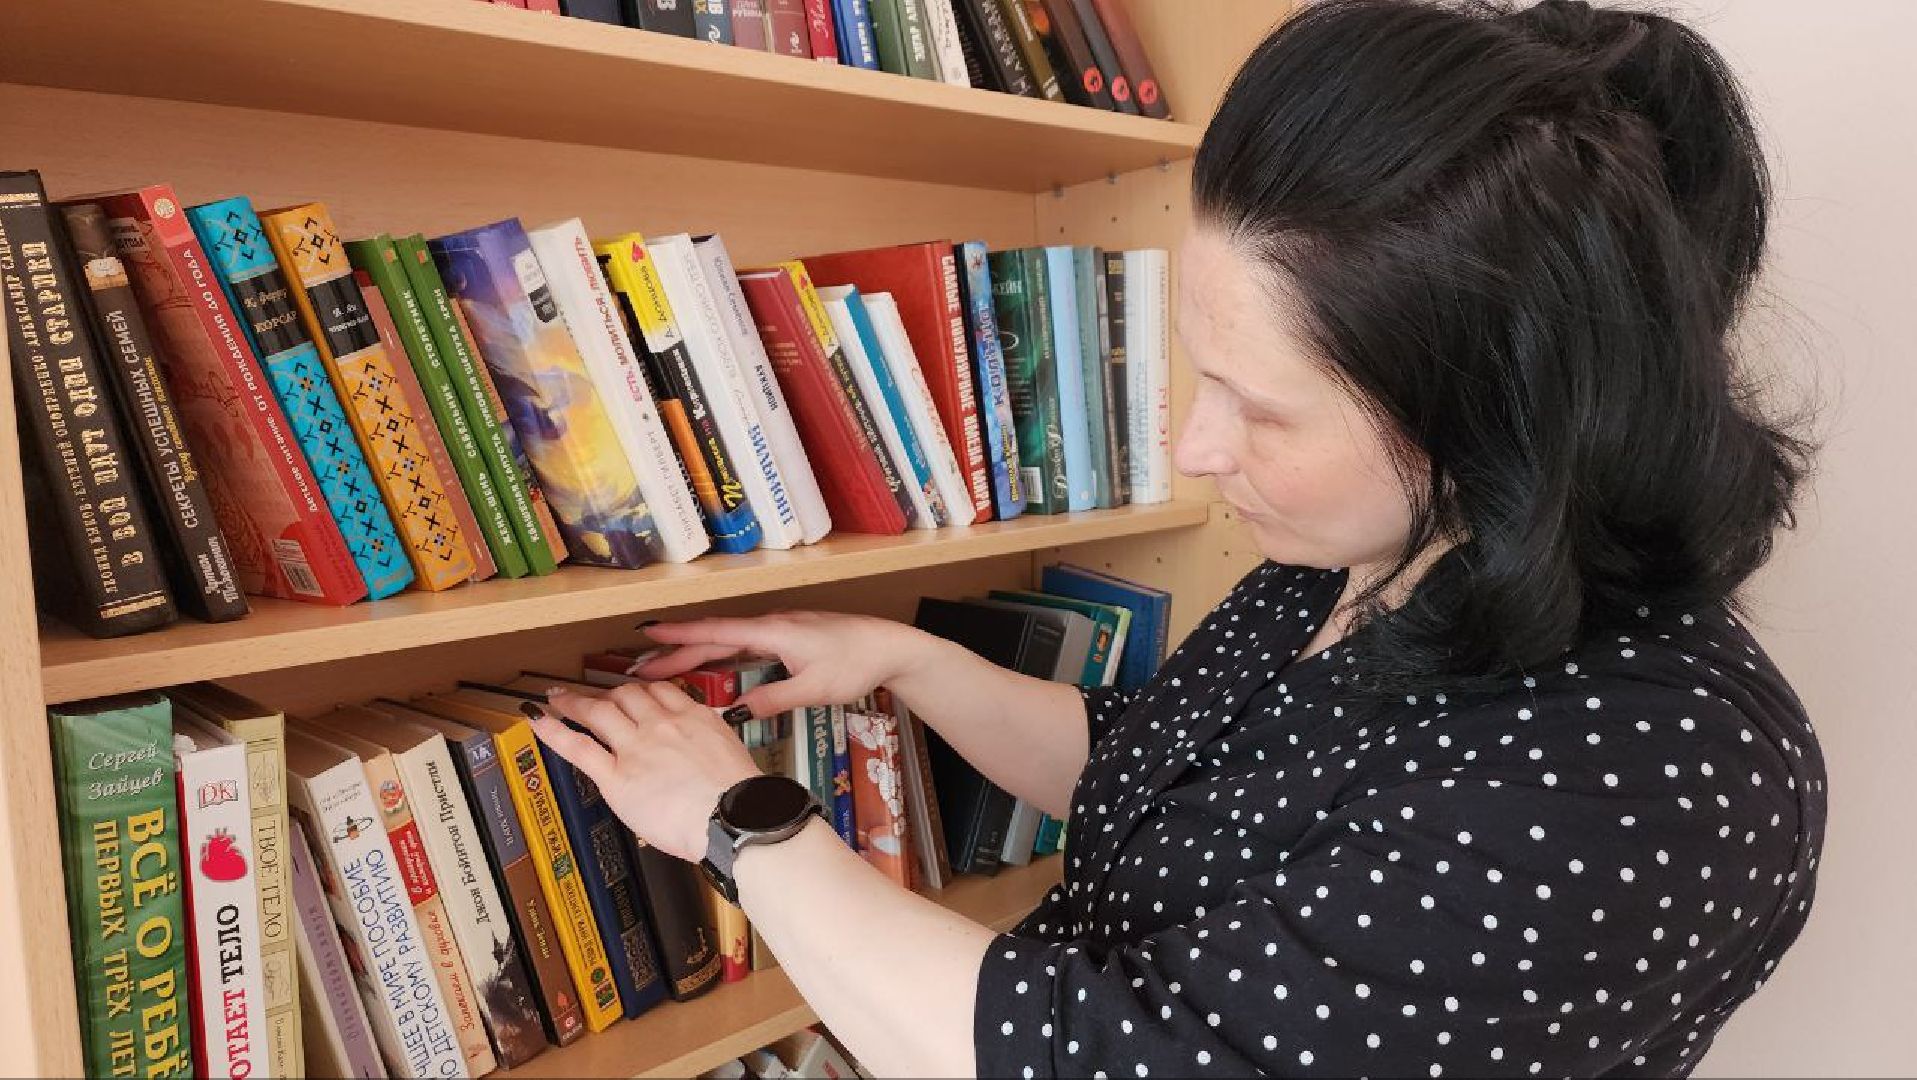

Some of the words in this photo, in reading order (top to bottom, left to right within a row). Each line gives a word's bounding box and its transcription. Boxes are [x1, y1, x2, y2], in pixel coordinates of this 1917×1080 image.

[20, 239, 76, 347] СТАРИКИ
[181, 248, 208, 288] ГОДА
[939, 255, 961, 312] САМЫЕ
[201, 290, 219, 311] ДО
[253, 310, 298, 333] КОРСАР
[400, 289, 441, 368] СТОЛЕТНИК
[431, 288, 452, 320] ХРЕН
[104, 309, 141, 364] СЕМЕЙ
[212, 313, 257, 390] РОЖДЕНИЯ
[446, 325, 474, 375] ШЕЛУХА
[129, 367, 174, 456] УСПЕШНЫХ
[251, 393, 267, 411] ОТ
[438, 383, 477, 458] САБЕЛЬНИК
[489, 433, 517, 482] КАПУСТА
[746, 424, 796, 524] ВИЛЬМОНТ
[97, 495, 137, 540] БОЙ
[163, 460, 200, 529] СЕКРЕТЫ
[475, 472, 513, 545] ЖЕНЬ-ШЕНЬ
[119, 550, 144, 566] В
[88, 740, 160, 771] Сергей
[88, 767, 163, 800] Зайцев
[202, 777, 233, 804] DK
[425, 759, 453, 822] Пристли
[125, 808, 177, 906] ВСЁ
[257, 820, 279, 877] ТВОЕ
[447, 824, 477, 886] Бойнтон
[92, 818, 127, 938] ПЕРВЫХ
[363, 848, 417, 955] РАЗВИТИЮ
[469, 887, 491, 926] Джон
[135, 915, 174, 958] О
[260, 879, 280, 937] ТЕЛО
[341, 858, 392, 958] ПОСОБИЕ
[214, 904, 243, 983] ТЕЛО
[440, 959, 453, 969] в
[102, 948, 134, 1015] ТРЁХ
[378, 958, 410, 1009] МИРЕ
[402, 960, 452, 1055] ДЕТСКОМУ
[449, 972, 475, 1032] Запекаем
[395, 1010, 415, 1025] В
[108, 1027, 137, 1080] ЛЕТ
